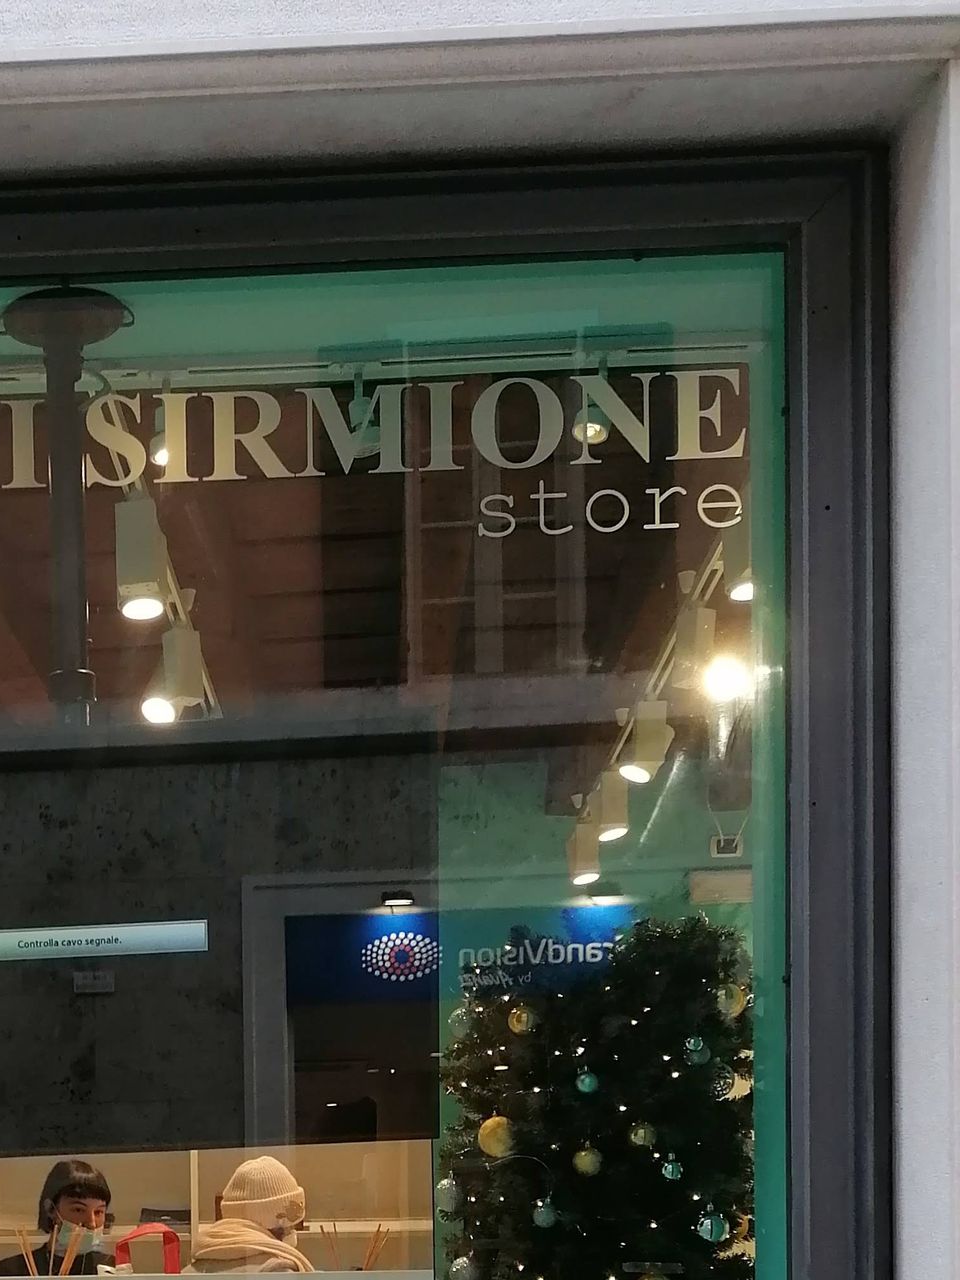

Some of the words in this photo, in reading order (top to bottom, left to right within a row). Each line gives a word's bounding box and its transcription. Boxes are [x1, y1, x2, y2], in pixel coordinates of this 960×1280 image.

[85, 367, 748, 488] SIRMIONE
[478, 479, 743, 538] store
[17, 938, 58, 950] Controlla
[60, 939, 83, 949] cavo
[85, 936, 122, 949] segnale.
